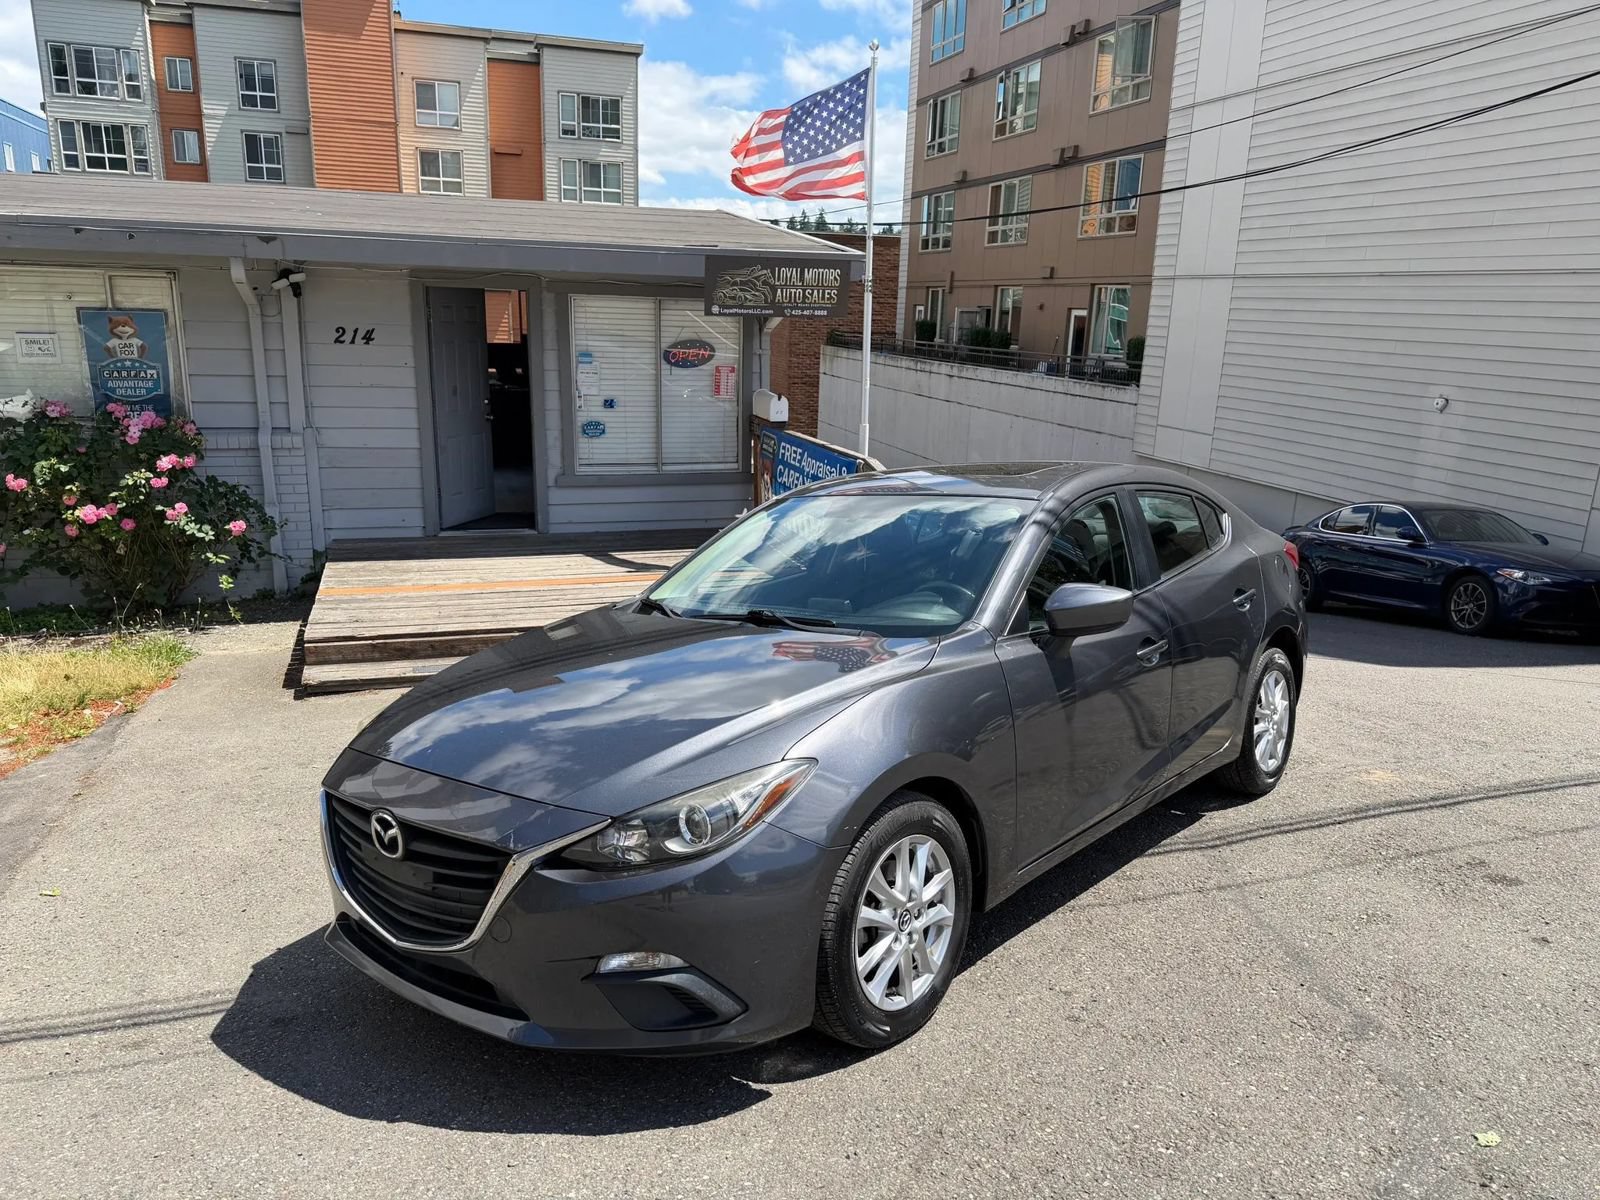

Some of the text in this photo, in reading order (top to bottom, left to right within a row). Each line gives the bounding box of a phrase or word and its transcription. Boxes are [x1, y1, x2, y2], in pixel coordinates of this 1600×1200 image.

[775, 267, 840, 286] LOYAL MOTORS
[775, 289, 837, 304] AUTO SALES
[334, 326, 375, 345] 214
[669, 347, 710, 362] OPEN
[103, 370, 157, 379] CARFAX
[107, 380, 154, 388] ADVANTAGE
[116, 388, 146, 396] DEALER
[779, 442, 802, 467] FREE
[800, 451, 839, 479] Appraisal
